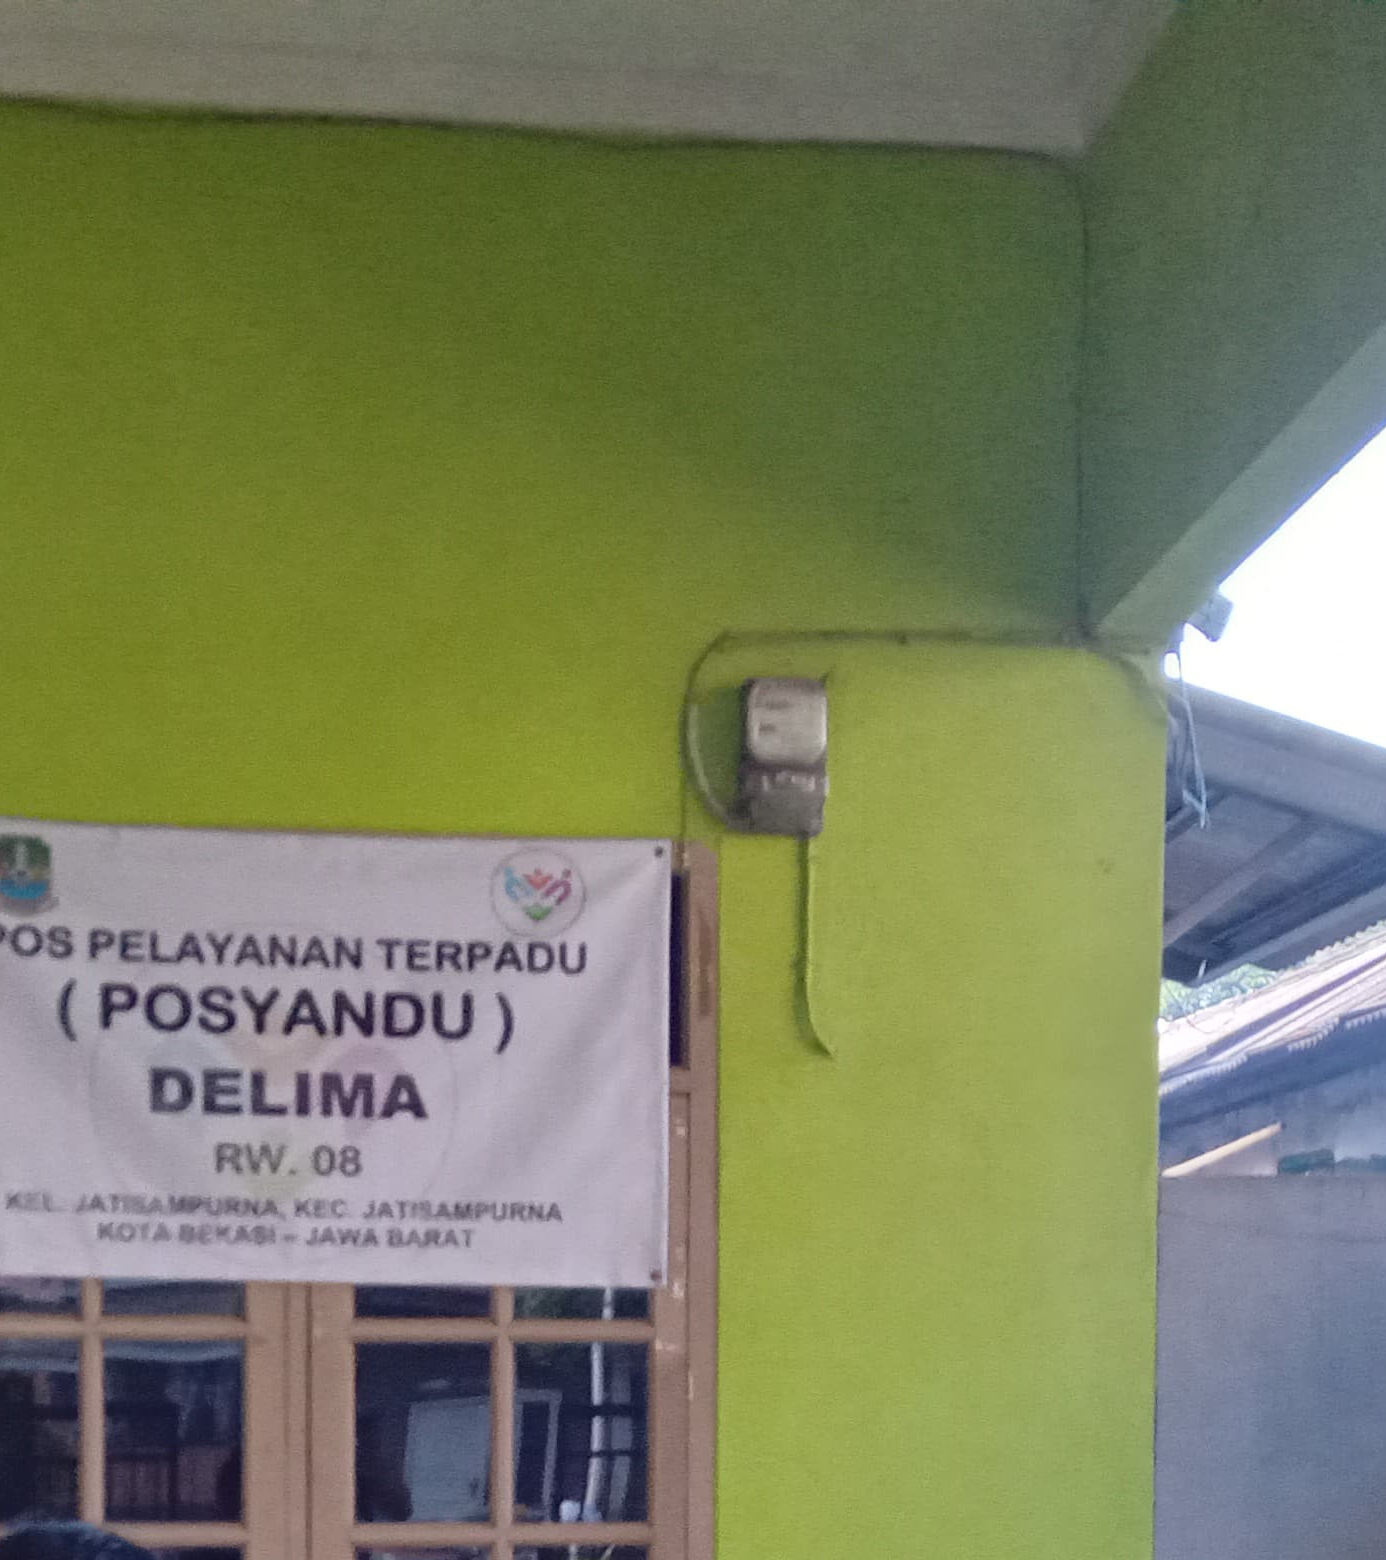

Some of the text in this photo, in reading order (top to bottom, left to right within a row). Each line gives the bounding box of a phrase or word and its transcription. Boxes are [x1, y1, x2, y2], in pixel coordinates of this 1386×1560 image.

[88, 928, 363, 970] PELAYANAN
[375, 937, 588, 976] TERPADU
[100, 982, 475, 1041] POSYANDU
[148, 1066, 429, 1119] DELIMA
[214, 1141, 363, 1178] RW. 08
[96, 1221, 172, 1244] KOTA
[177, 1223, 278, 1246] BEKASI
[305, 1226, 381, 1248] JAWA
[385, 1228, 477, 1249] BARAT
